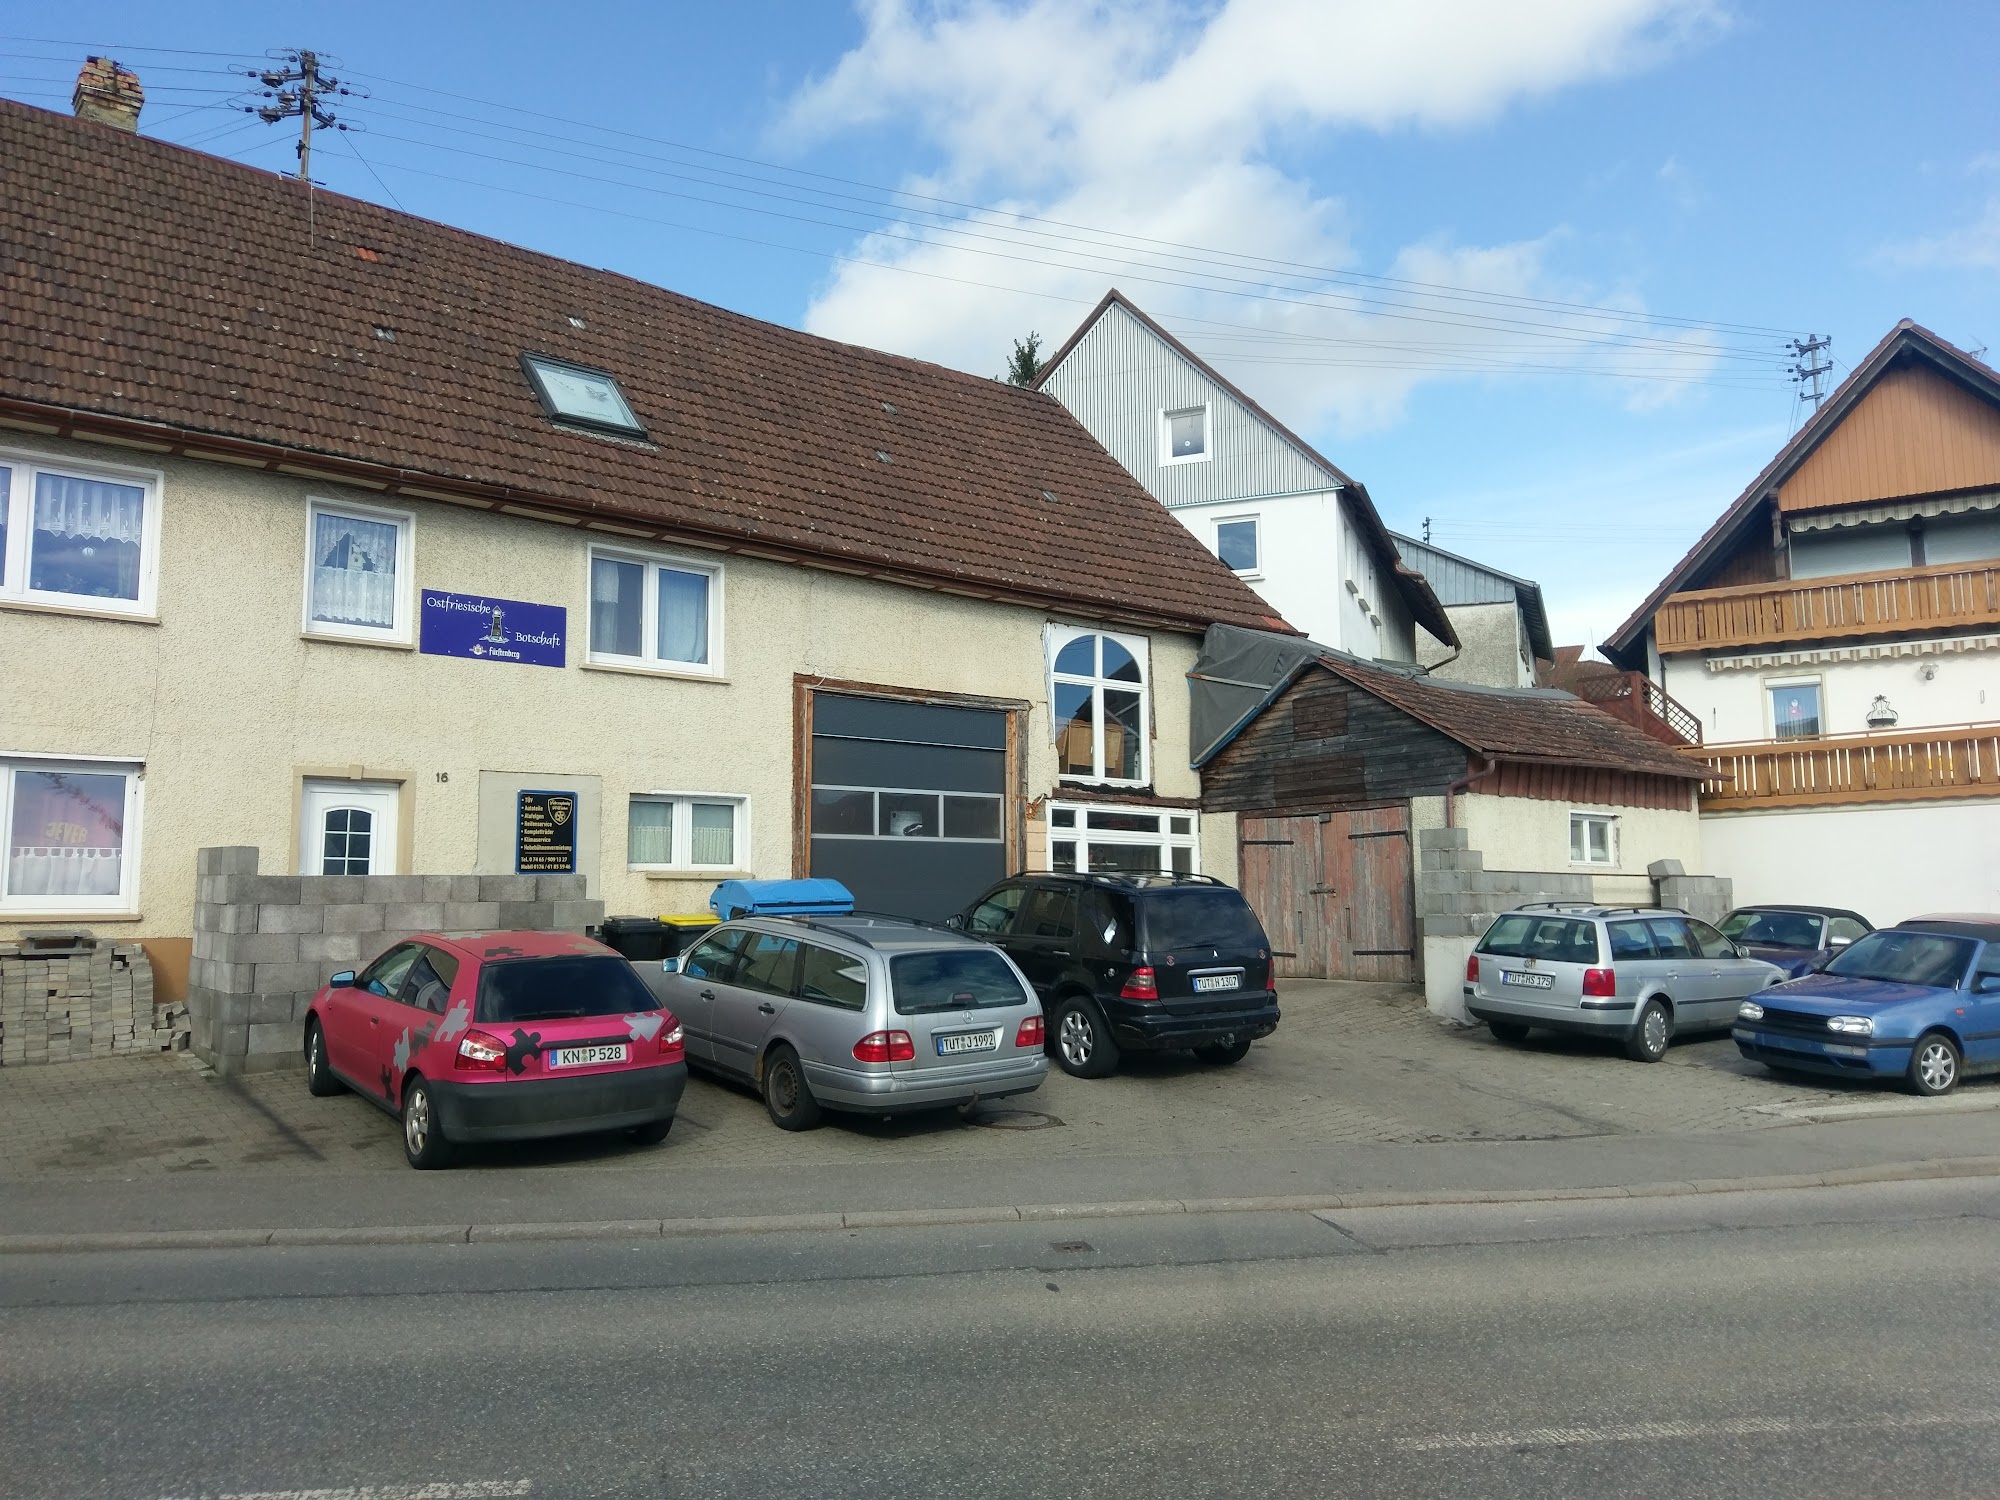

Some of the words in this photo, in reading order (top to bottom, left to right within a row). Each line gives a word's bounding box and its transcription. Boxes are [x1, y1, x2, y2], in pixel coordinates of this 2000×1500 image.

[427, 596, 491, 614] Ostfriesische
[515, 631, 561, 648] Botschaft
[436, 772, 448, 783] 16
[1197, 978, 1210, 988] TUT
[1509, 973, 1521, 983] TUT
[1526, 975, 1535, 984] HS
[1537, 976, 1550, 986] 175
[943, 1037, 960, 1050] TUT
[967, 1036, 972, 1047] J
[973, 1034, 993, 1047] 1992
[563, 1049, 580, 1063] KN
[589, 1048, 596, 1061] P
[599, 1047, 621, 1060] 528
